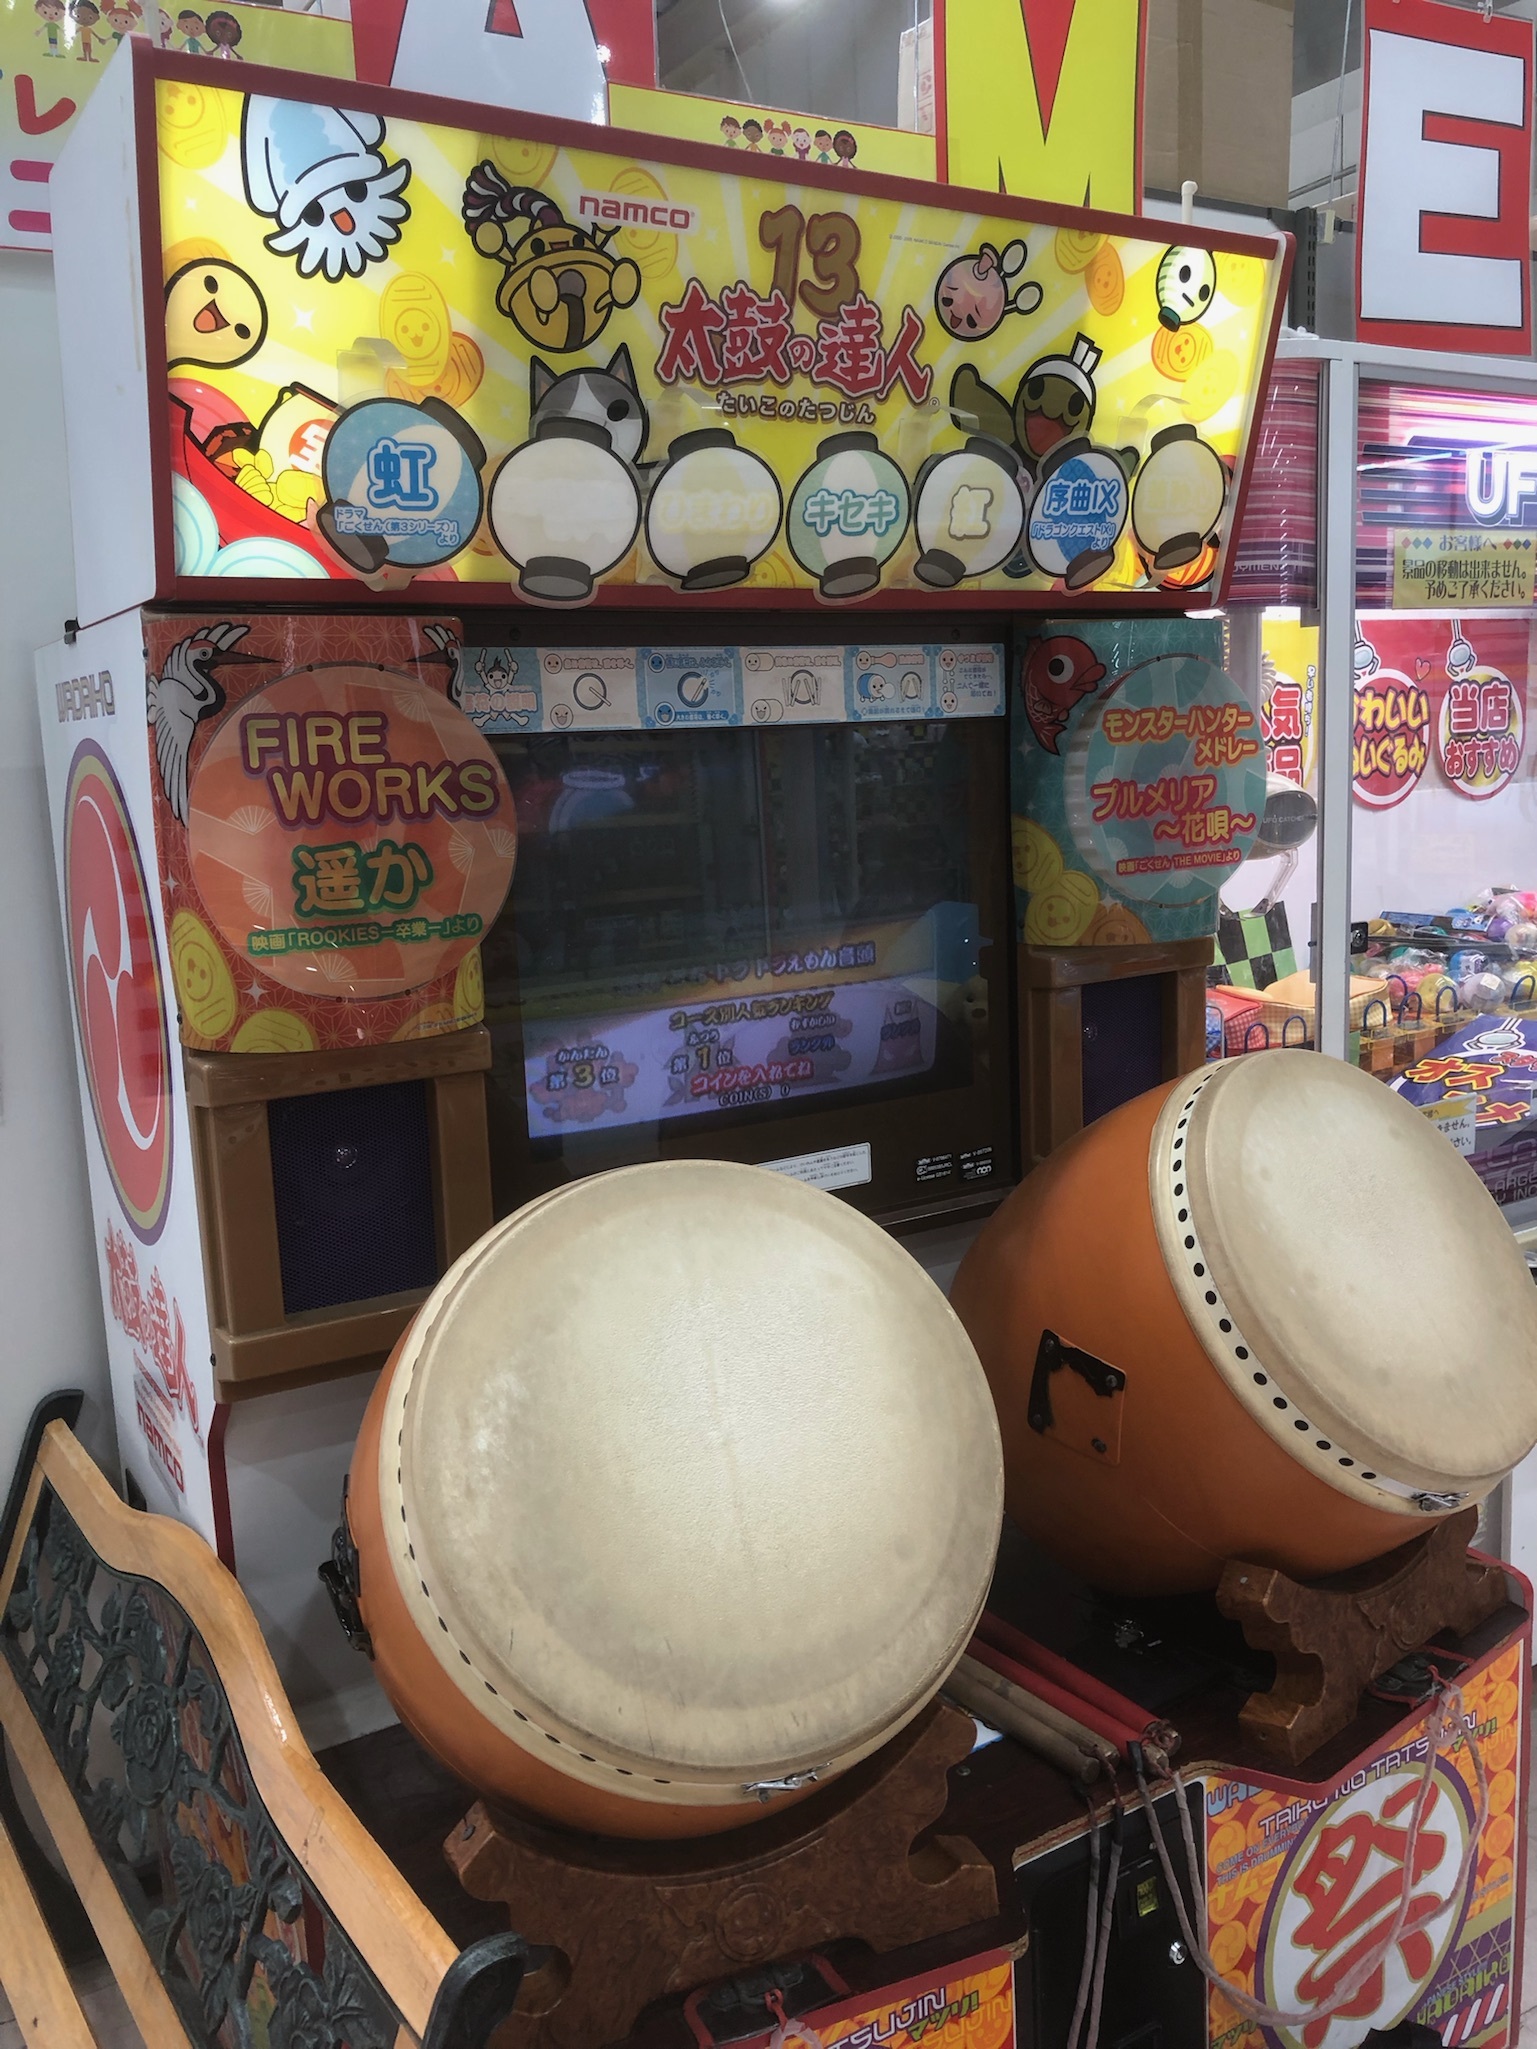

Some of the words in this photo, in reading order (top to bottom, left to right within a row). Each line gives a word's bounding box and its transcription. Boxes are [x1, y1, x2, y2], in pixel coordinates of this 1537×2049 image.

[1360, 27, 1525, 331] E
[579, 194, 690, 230] namco
[759, 204, 861, 318] 13
[655, 277, 933, 404] 太鼓の達人
[716, 391, 876, 424] たいこのたつじん
[370, 440, 436, 507] 虹
[335, 506, 367, 520] ドラマ
[804, 488, 898, 536] キセキ
[437, 534, 460, 546] より
[1091, 537, 1112, 551] より
[1439, 535, 1497, 552] お客様へ
[1402, 559, 1527, 579] 景品の移動は出来ません。
[1425, 580, 1526, 600] 予めご了承ください。
[1104, 705, 1254, 744] モンスターハンター
[1449, 680, 1512, 736] 当店
[243, 714, 387, 772] FIRE
[1195, 738, 1259, 768] メドレー
[1445, 734, 1518, 780] おすすめ
[271, 764, 499, 828] WORKS
[1092, 776, 1217, 821] プルメリア
[294, 841, 432, 914] 遥か
[1174, 855, 1192, 868] THE
[691, 1057, 813, 1097] コインを入れてね
[136, 1399, 185, 1494] namco
[1217, 1868, 1239, 1886] THIS
